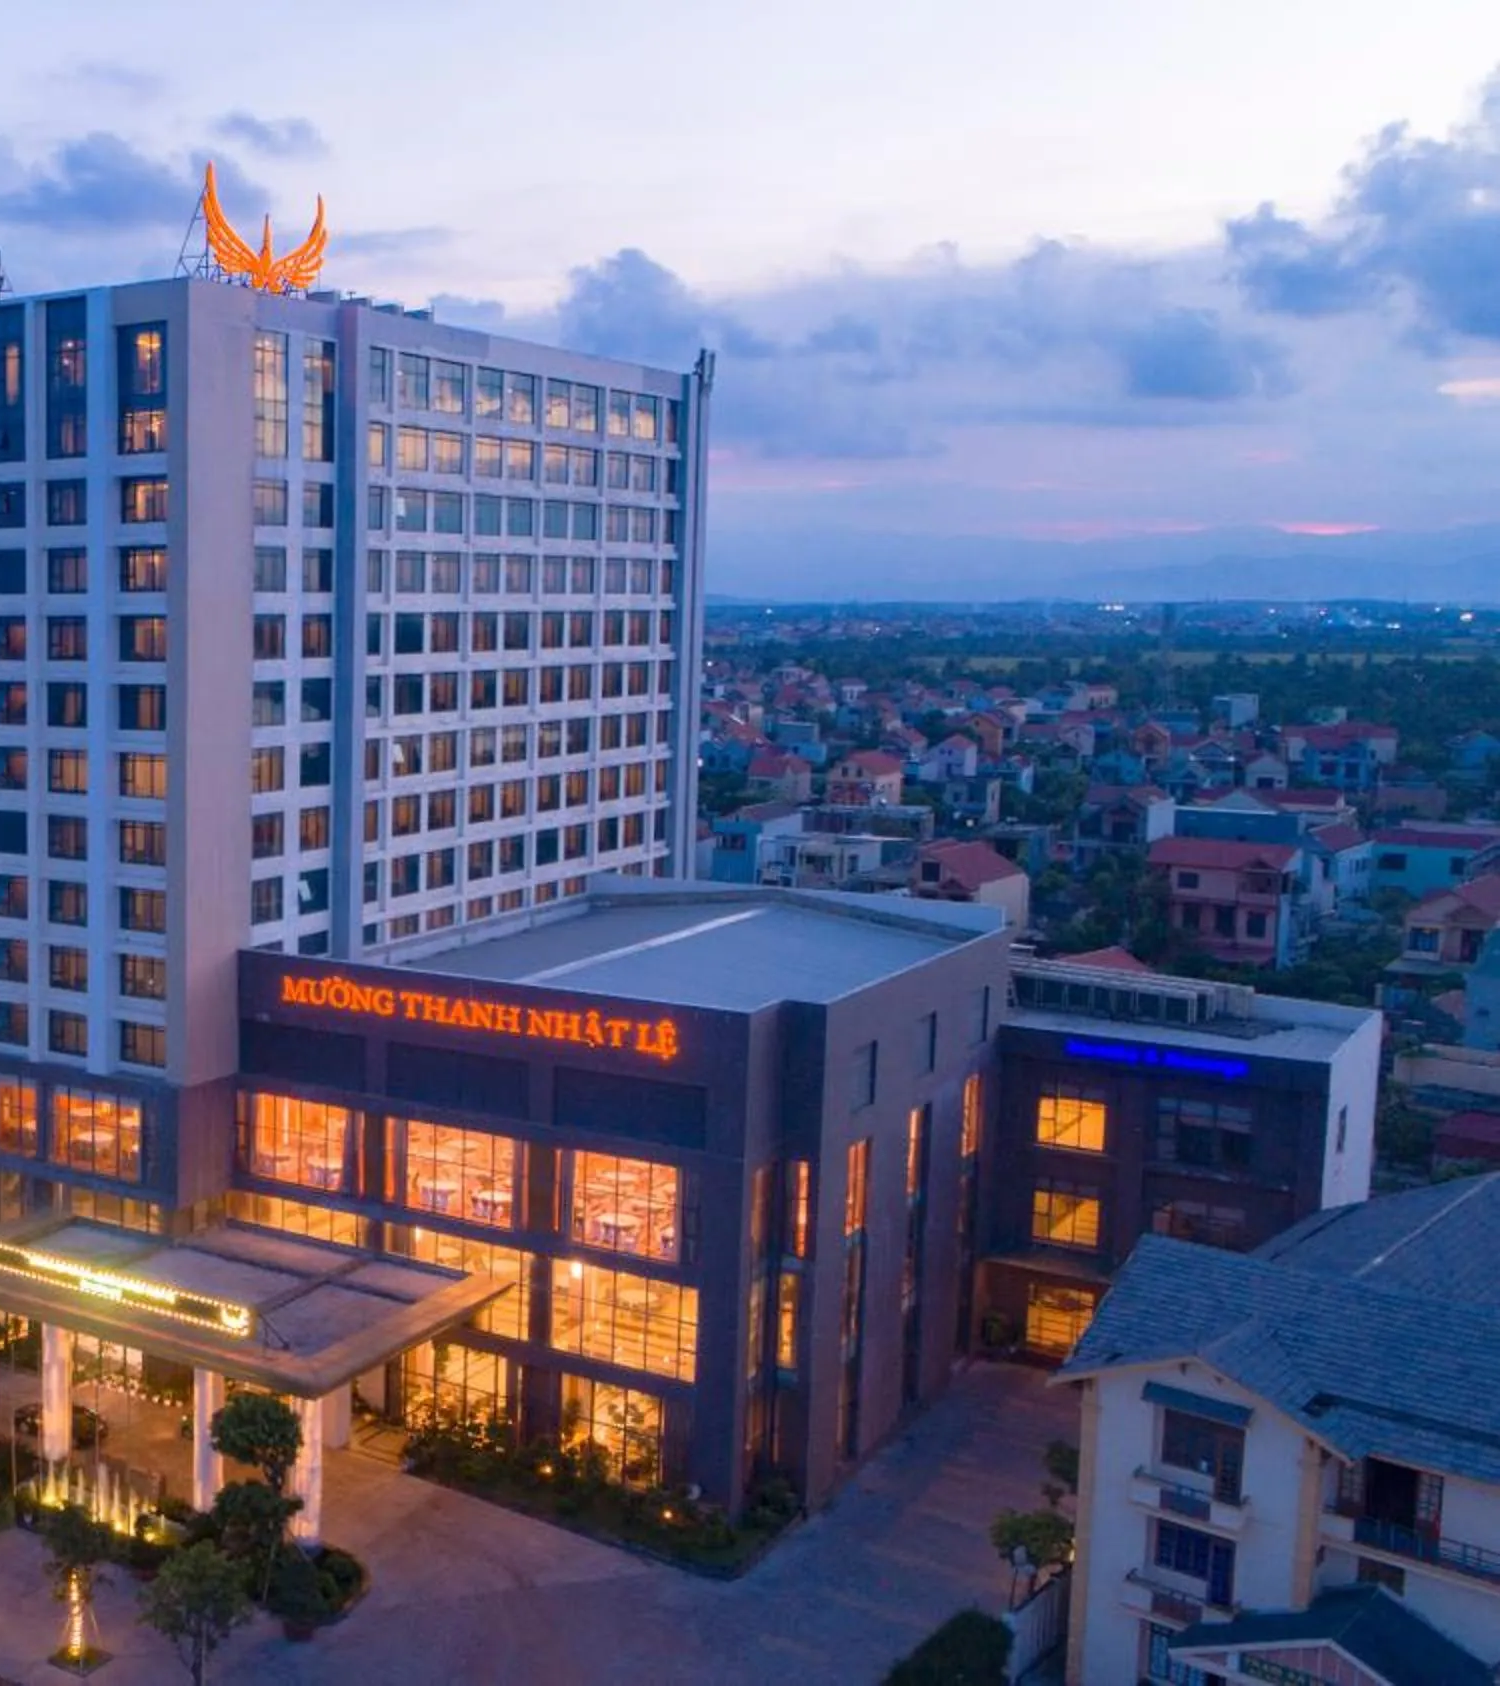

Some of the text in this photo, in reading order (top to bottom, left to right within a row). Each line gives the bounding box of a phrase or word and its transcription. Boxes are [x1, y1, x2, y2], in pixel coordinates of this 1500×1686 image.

[282, 976, 677, 1060] MƯỜNG THANH NHẬT LỆ
